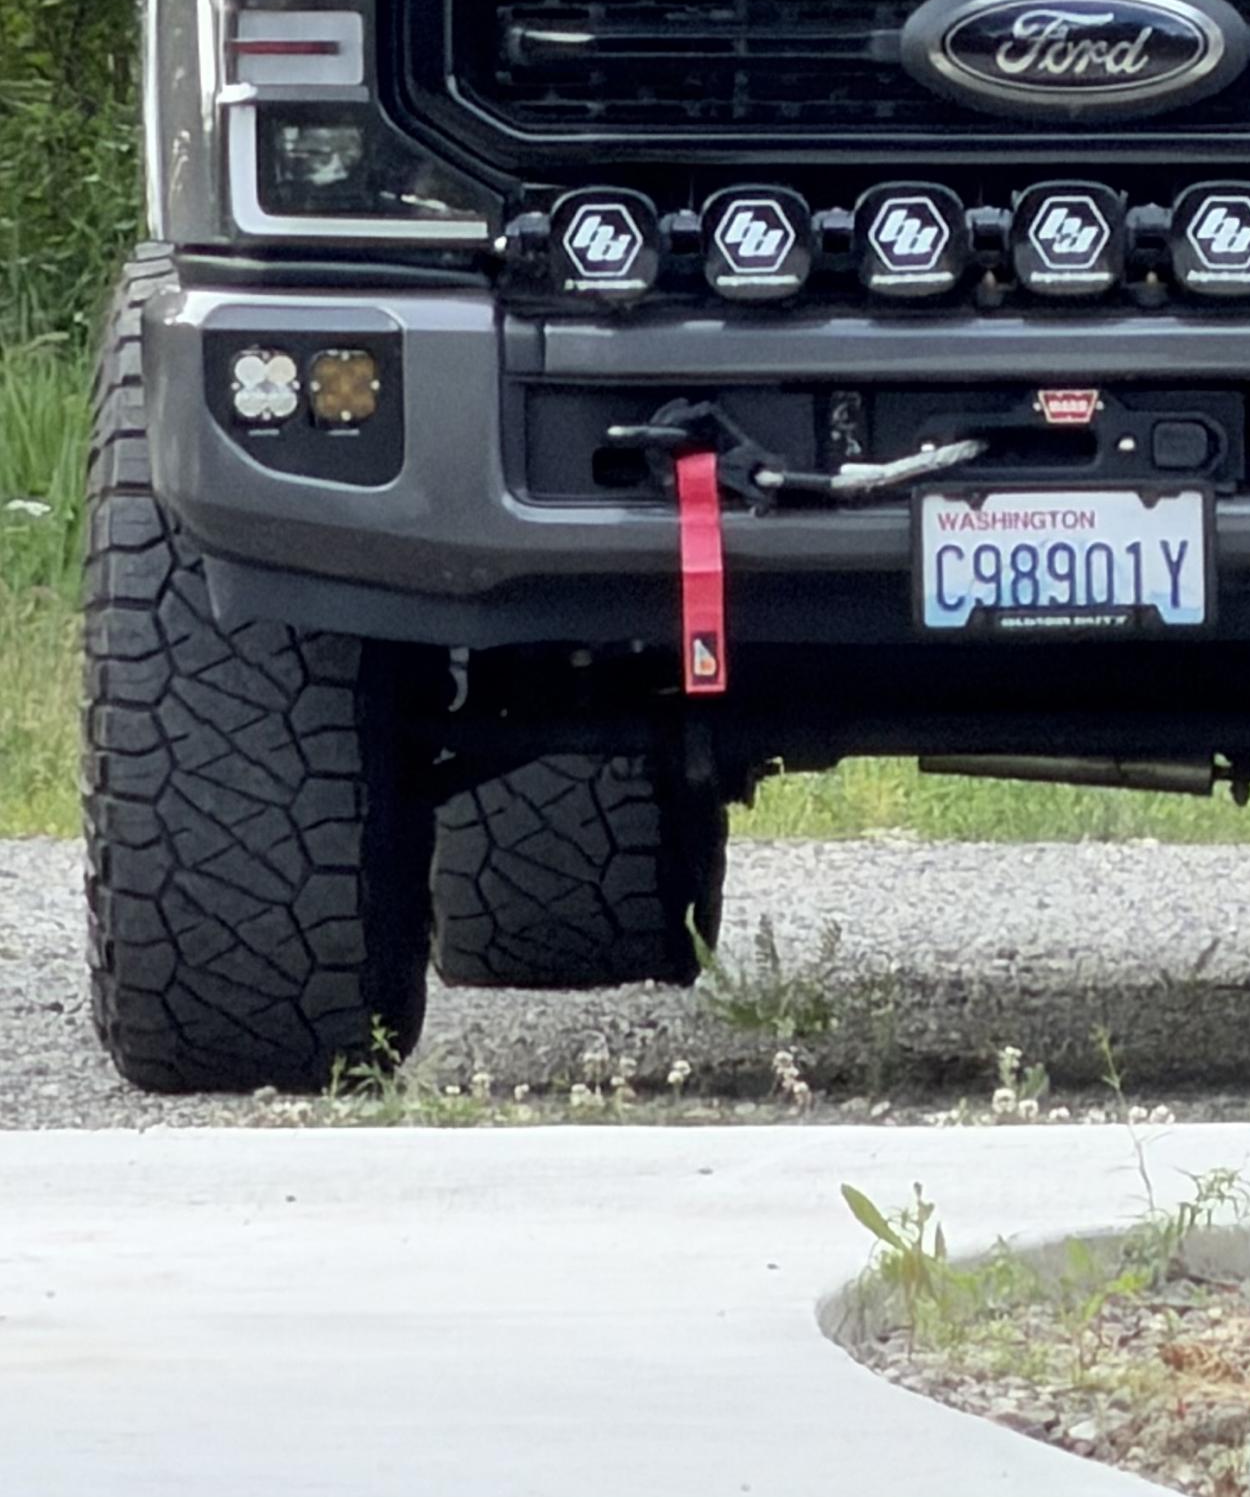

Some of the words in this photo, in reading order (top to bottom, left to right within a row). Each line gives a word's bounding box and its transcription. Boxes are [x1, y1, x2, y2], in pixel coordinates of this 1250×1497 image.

[995, 8, 1153, 75] Ford
[937, 510, 1097, 531] WASHINGTON
[935, 539, 1190, 613] C98901Y
